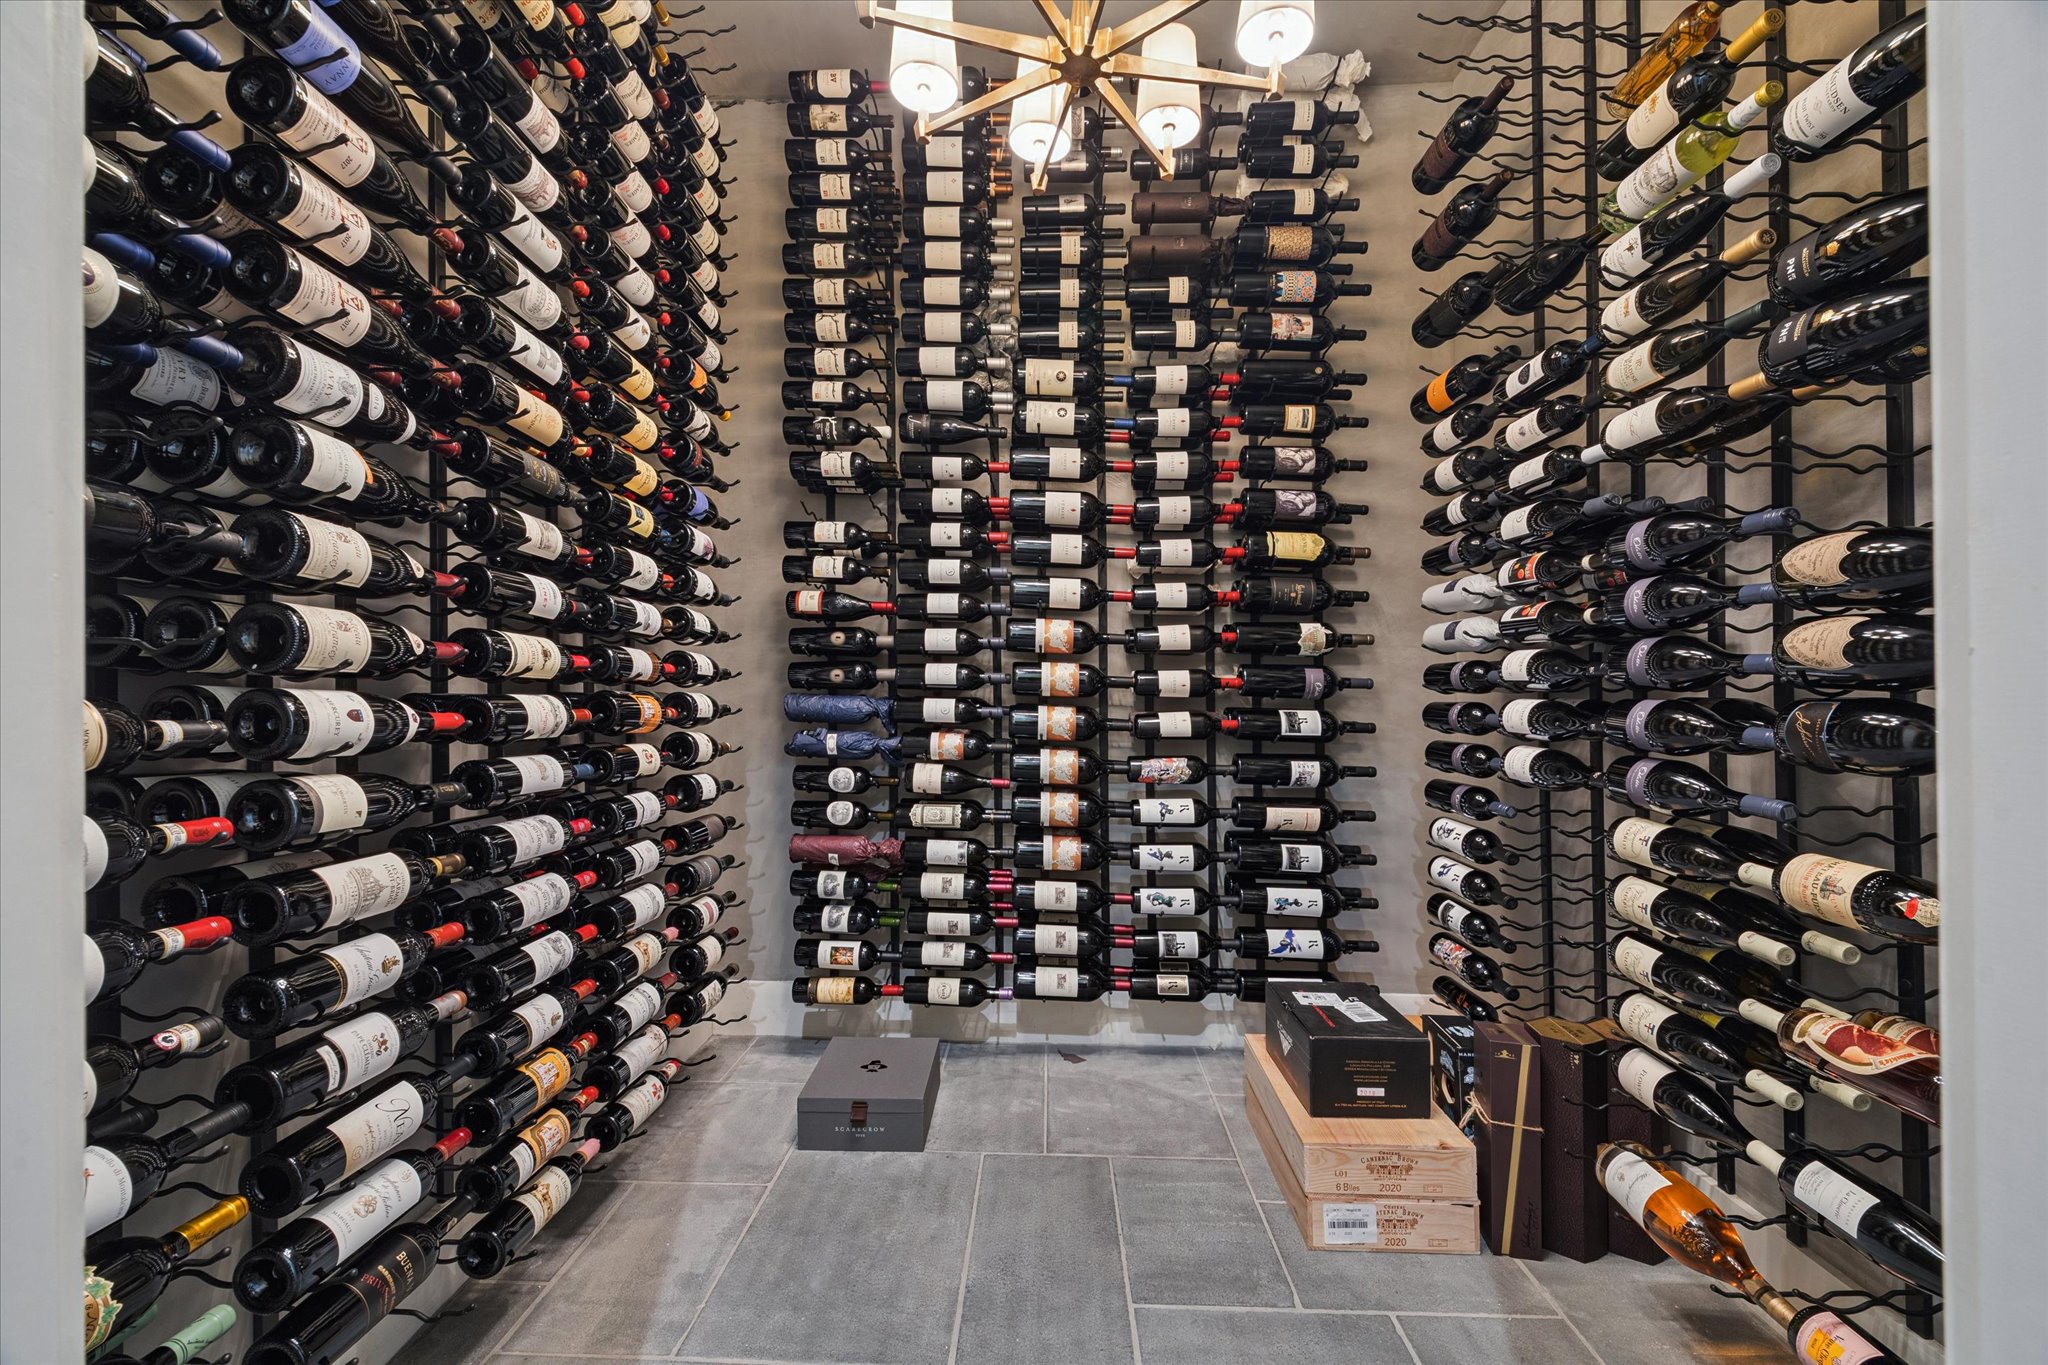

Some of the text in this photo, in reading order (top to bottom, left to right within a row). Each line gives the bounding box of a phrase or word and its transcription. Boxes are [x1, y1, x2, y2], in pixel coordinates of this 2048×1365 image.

[829, 72, 838, 83] BV
[1832, 67, 1851, 115] KNUDSEN
[340, 233, 352, 249] 2017
[325, 697, 341, 737] MERCUREY
[1360, 1154, 1419, 1165] CANTENAC BROWN
[1335, 1182, 1342, 1191] 6
[1379, 1183, 1402, 1193] 2020
[1402, 1208, 1424, 1219] BROWN
[332, 1210, 353, 1234] MARGAUX
[1384, 1237, 1407, 1247] 2020
[396, 1251, 415, 1285] BUENA
[1825, 1334, 1845, 1348] Veuve
